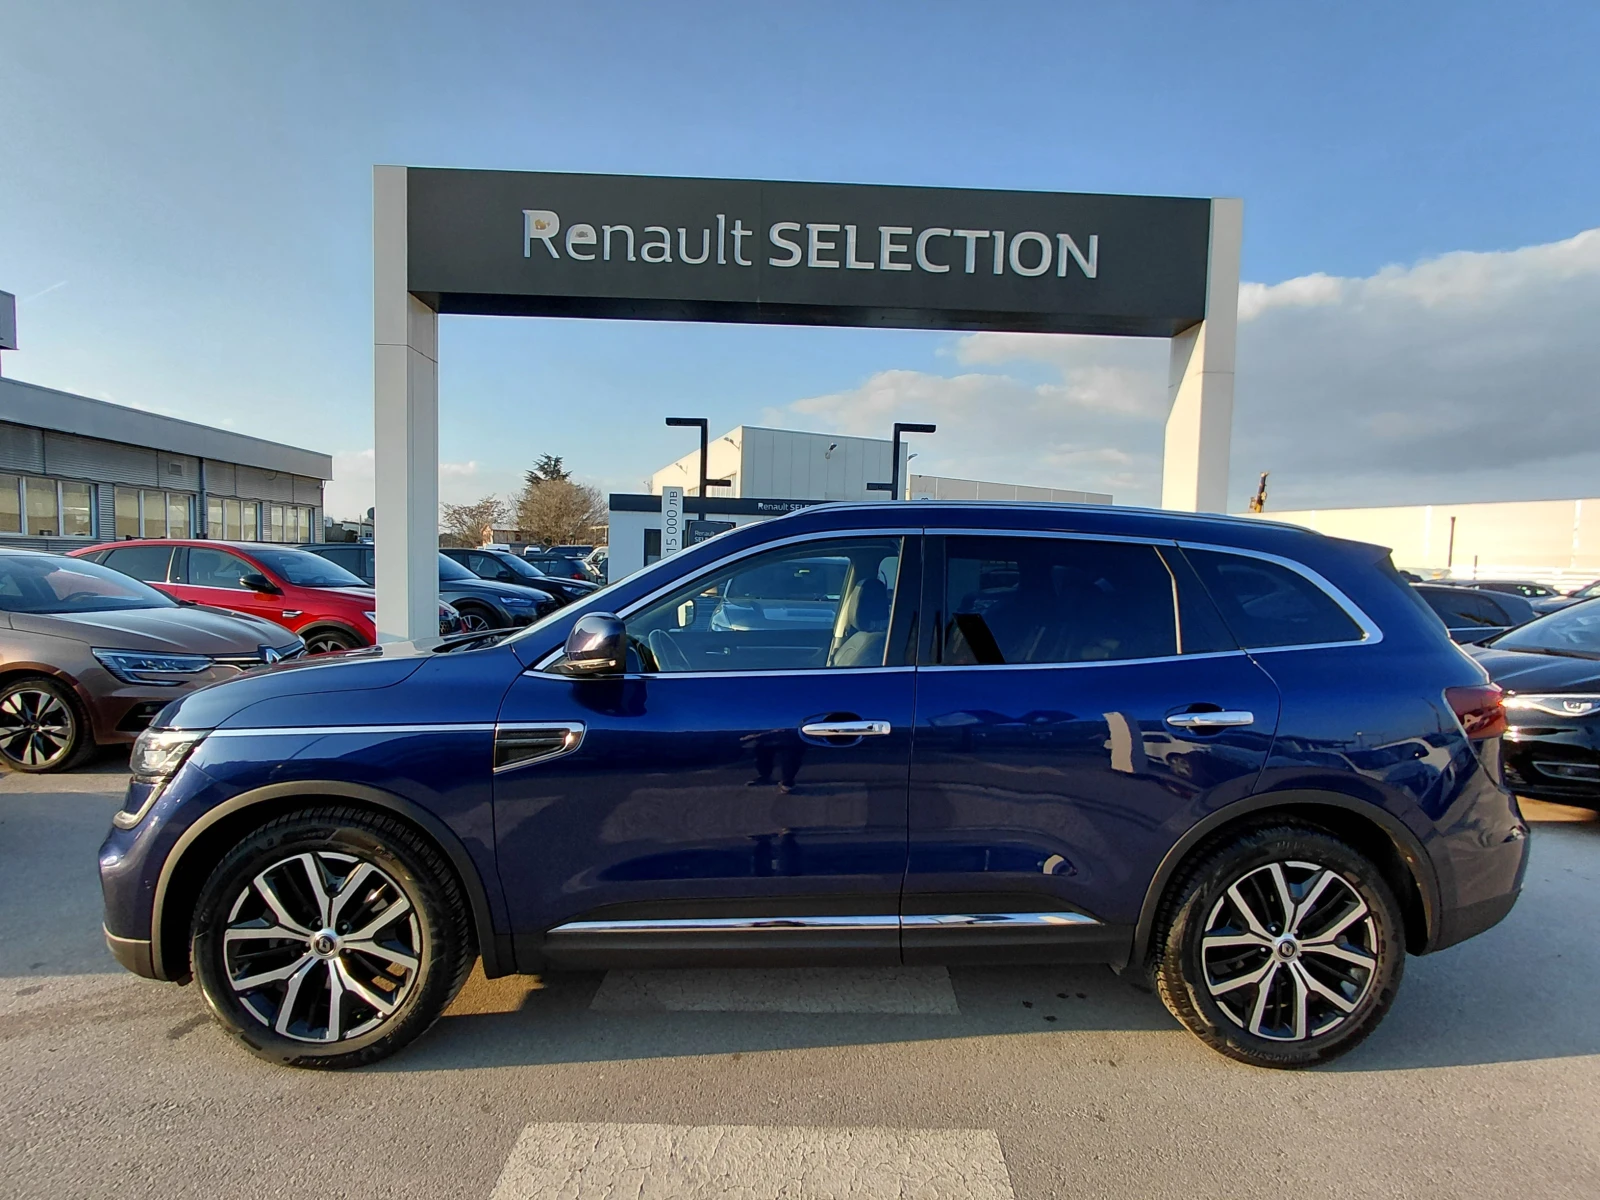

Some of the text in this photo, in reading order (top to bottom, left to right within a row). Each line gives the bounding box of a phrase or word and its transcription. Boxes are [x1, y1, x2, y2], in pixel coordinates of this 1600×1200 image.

[521, 209, 1099, 279] Renault SELECTION
[757, 502, 789, 511] Renault
[666, 509, 678, 535] 000
[666, 538, 677, 553] 15
